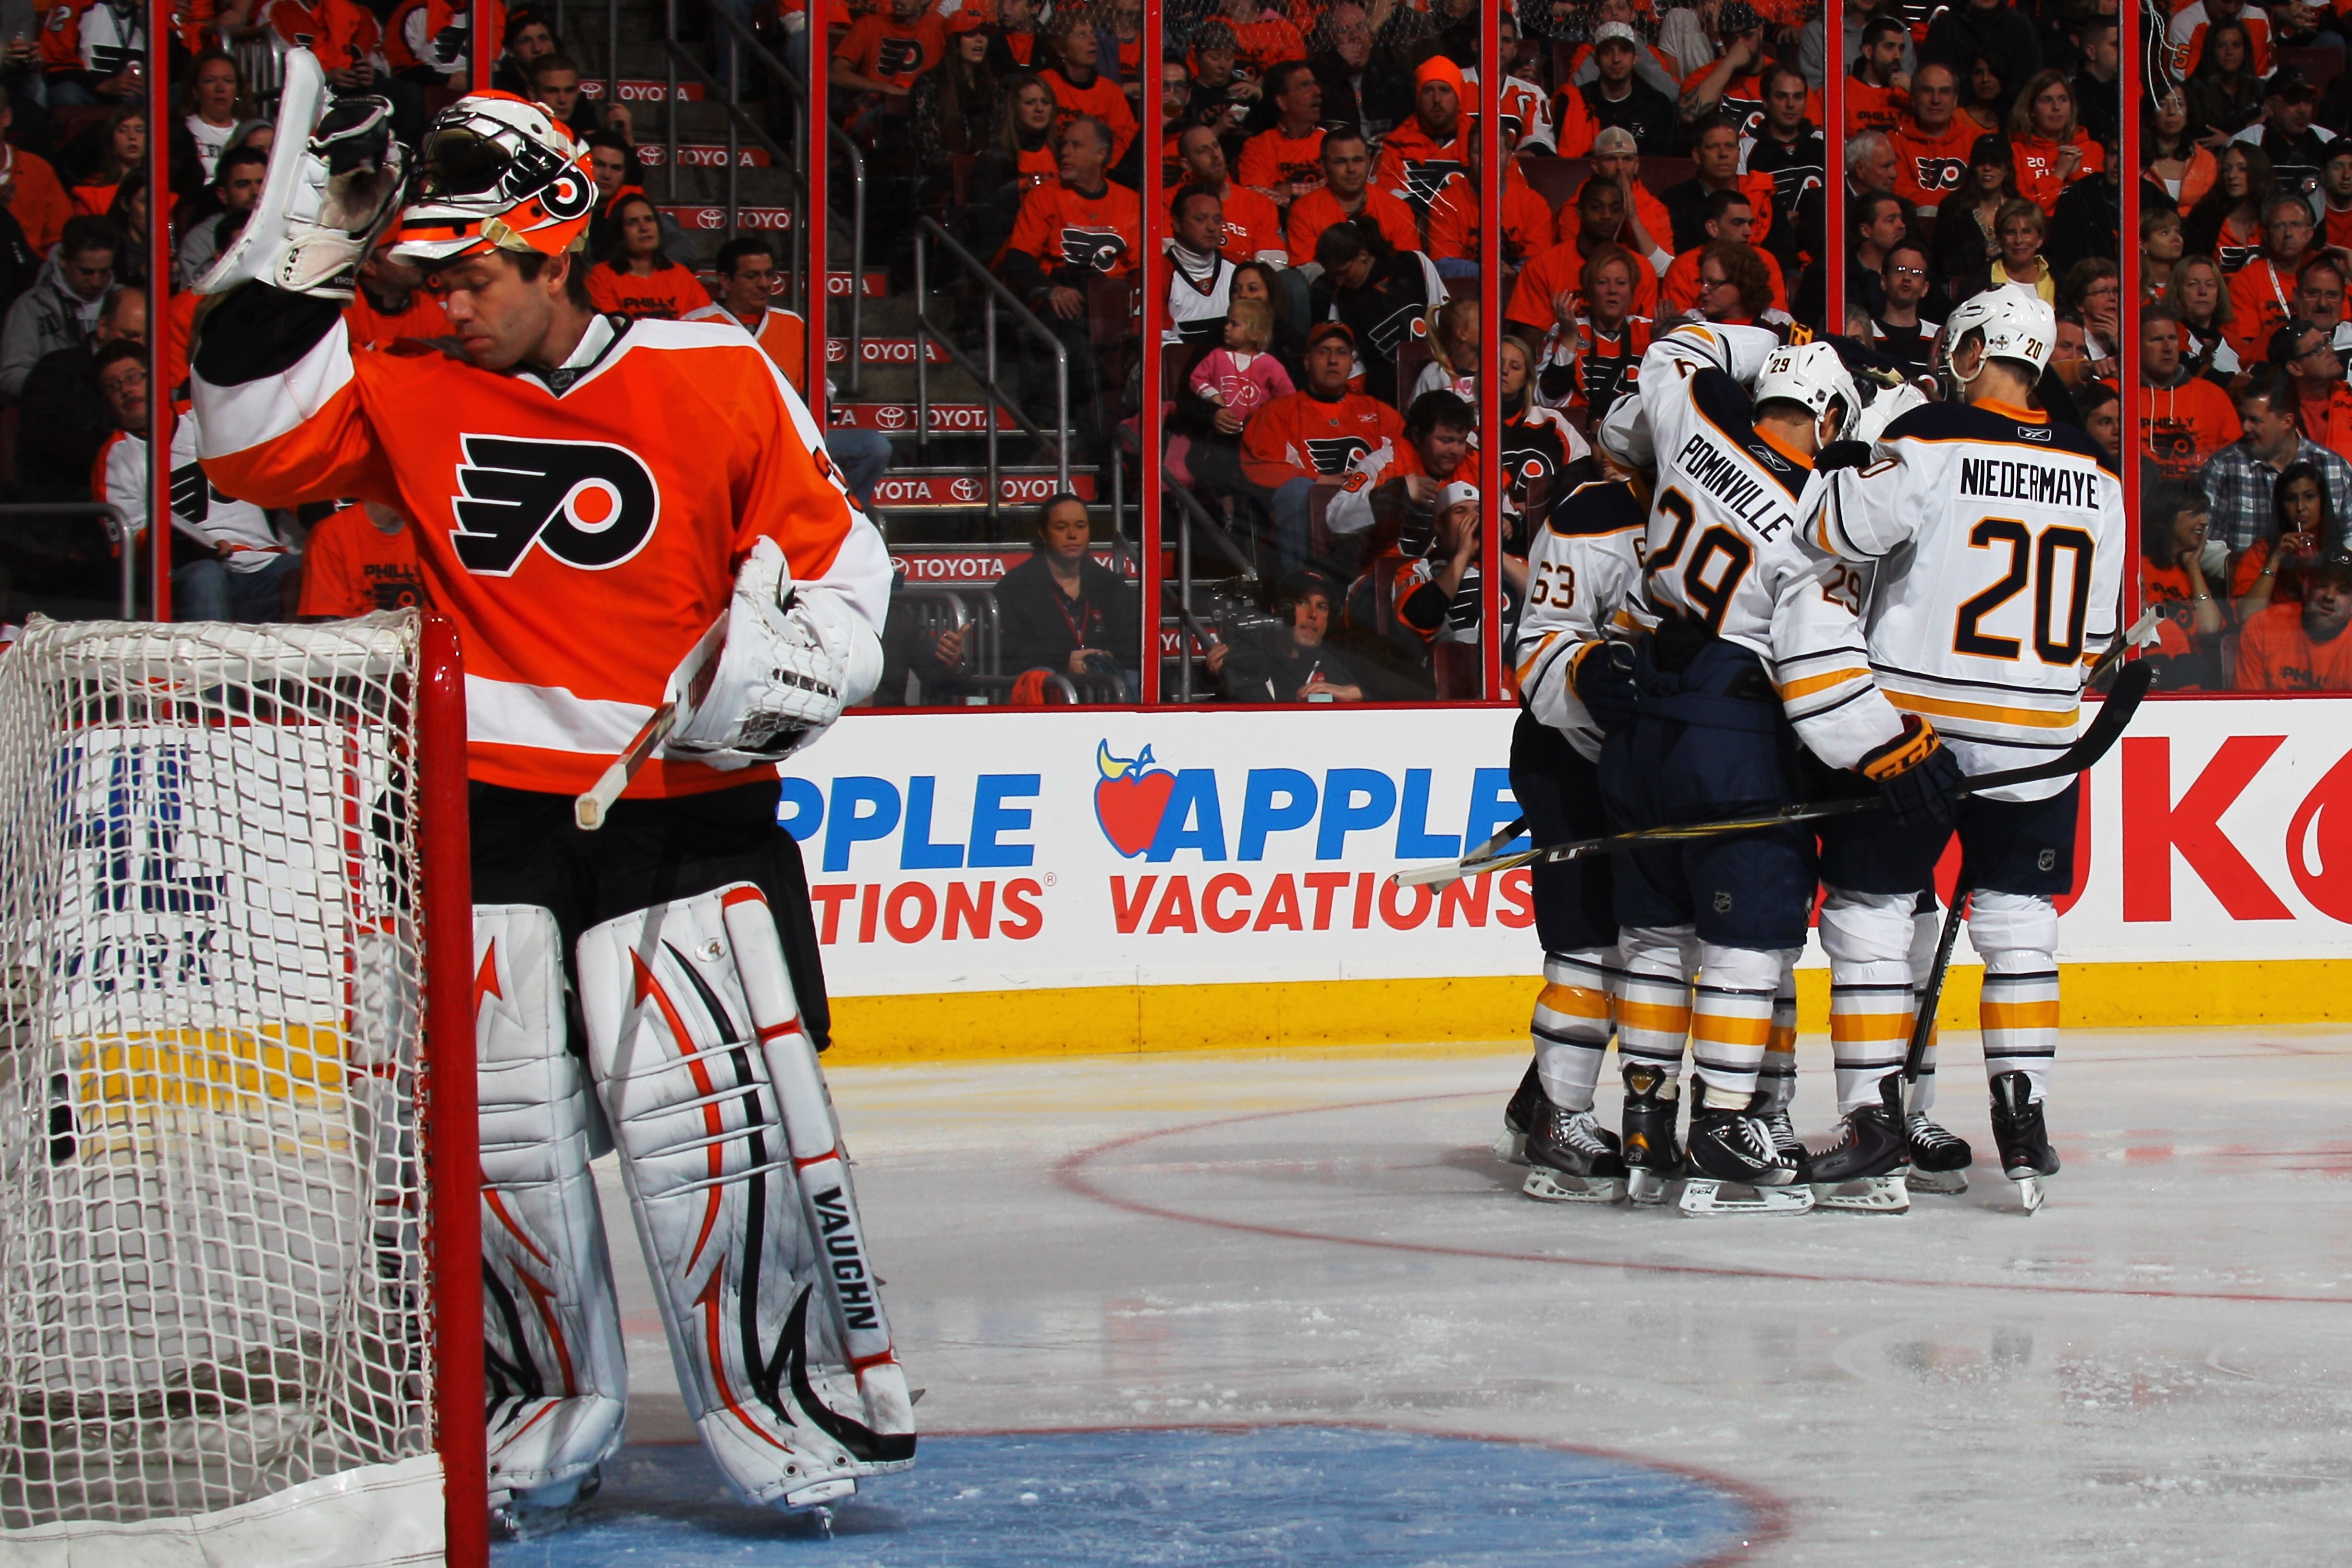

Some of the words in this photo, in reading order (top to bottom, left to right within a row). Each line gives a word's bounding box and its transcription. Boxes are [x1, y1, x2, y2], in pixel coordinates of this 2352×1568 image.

[617, 86, 688, 101] OYOA
[677, 149, 754, 167] TOYOA
[1221, 222, 1248, 237] ERS
[624, 296, 675, 308] PHILLY
[861, 344, 936, 361] OYOTA
[1770, 357, 1791, 373] 29
[2024, 337, 2043, 360] 20
[875, 482, 931, 500] YOTA
[998, 480, 1077, 499] OYOTA
[1676, 433, 1794, 543] POMINVILLE
[913, 558, 1006, 577] TOYOTA
[1645, 485, 1754, 635] 29
[1531, 561, 1575, 609] 63
[1822, 563, 1861, 617] 29
[1952, 516, 2096, 666] 20
[775, 773, 1041, 872] PPLE
[1145, 767, 1532, 862] APPLE
[811, 877, 1043, 945] TIONS
[1109, 869, 1536, 934] VACATIONS
[1628, 1152, 1642, 1162] 29
[813, 1186, 879, 1330] VAUGHN
